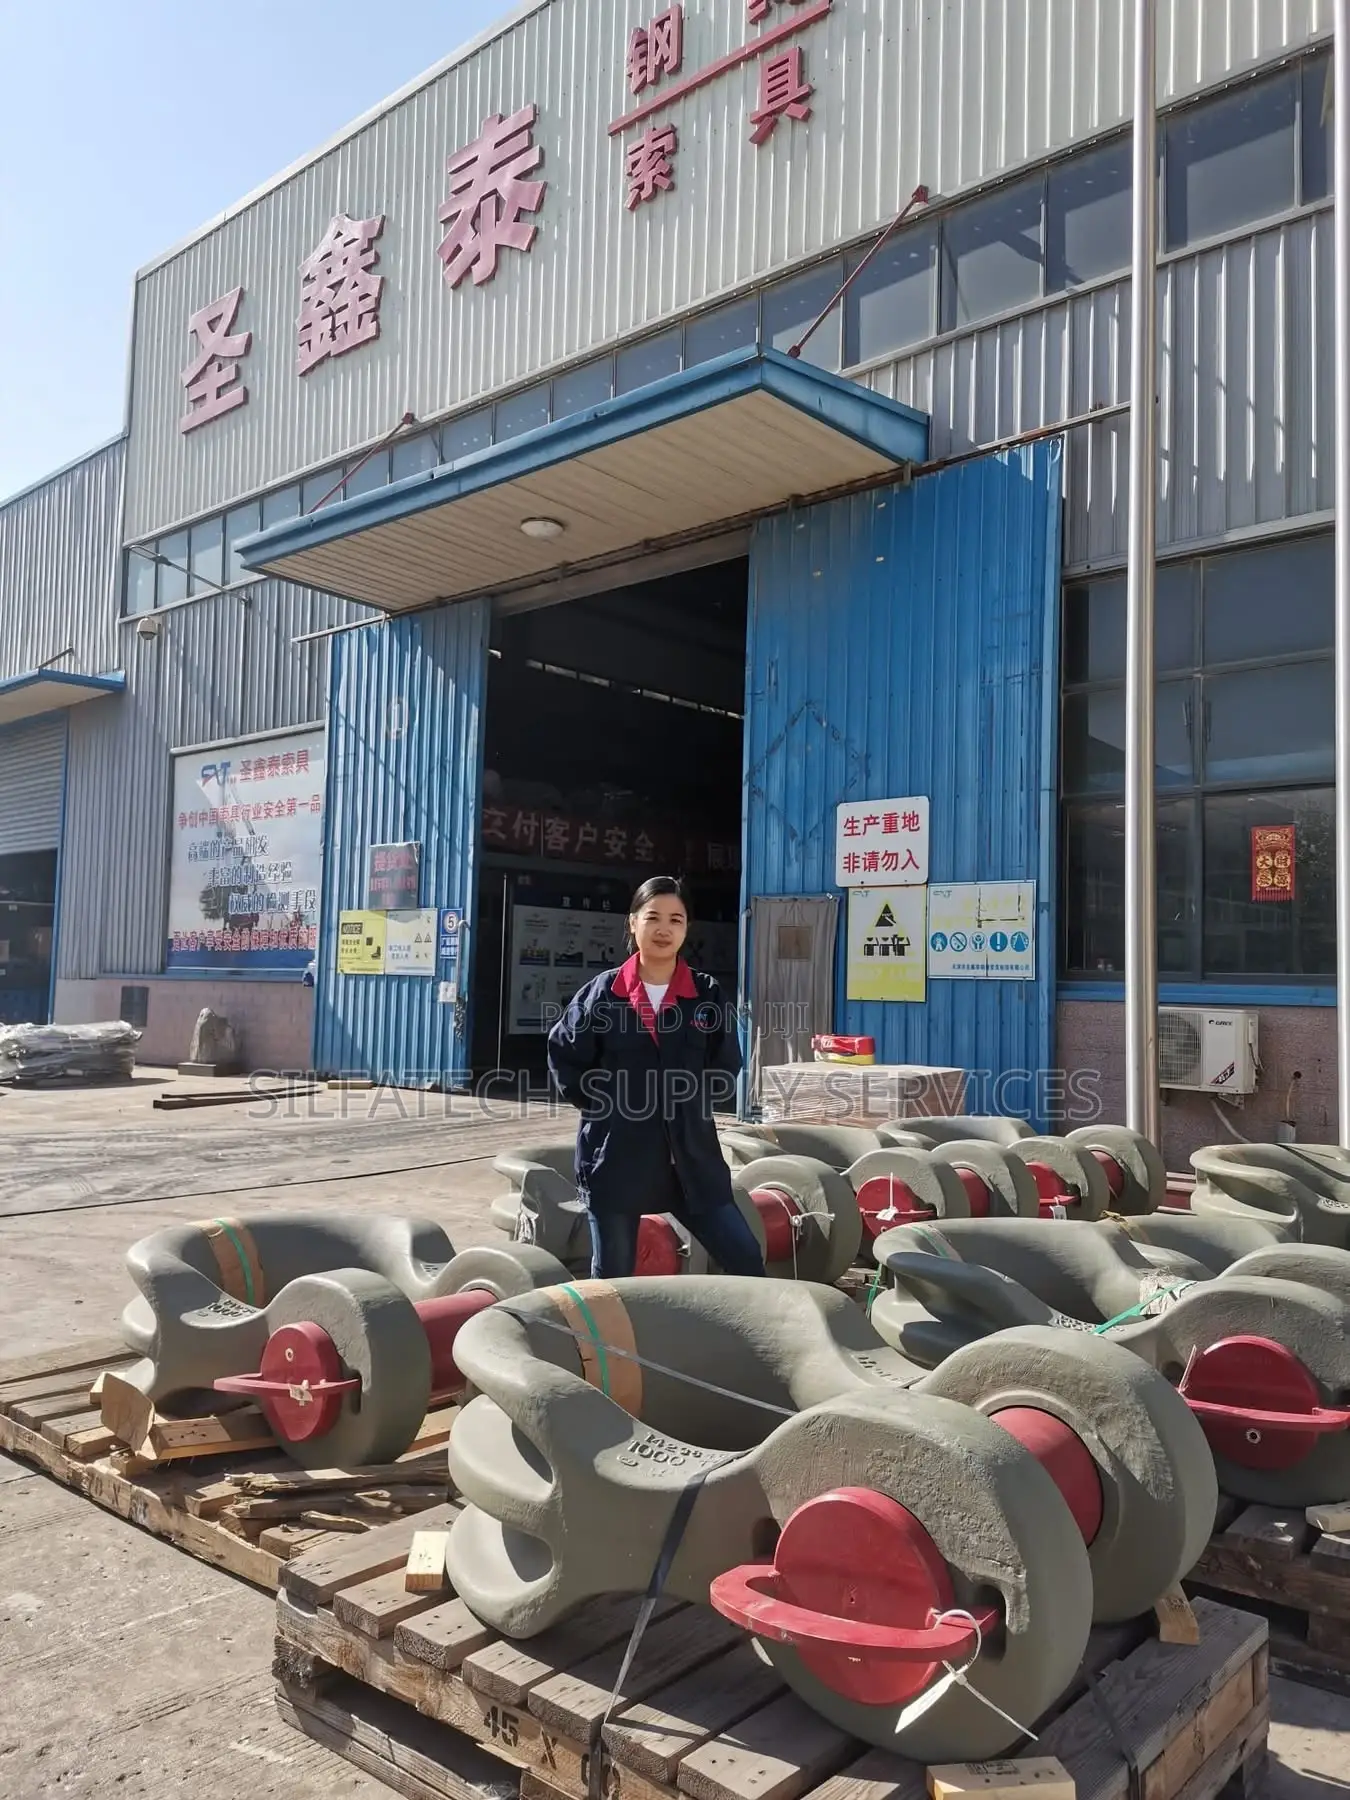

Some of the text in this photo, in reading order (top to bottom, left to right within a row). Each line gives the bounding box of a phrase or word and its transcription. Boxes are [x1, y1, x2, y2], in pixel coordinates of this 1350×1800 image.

[180, 103, 547, 436] 圣鑫泰
[240, 748, 309, 783] 圣鑫泰索具
[843, 809, 921, 838] 生产重地
[842, 848, 920, 874] 非请勿入
[627, 1439, 687, 1467] 1000
